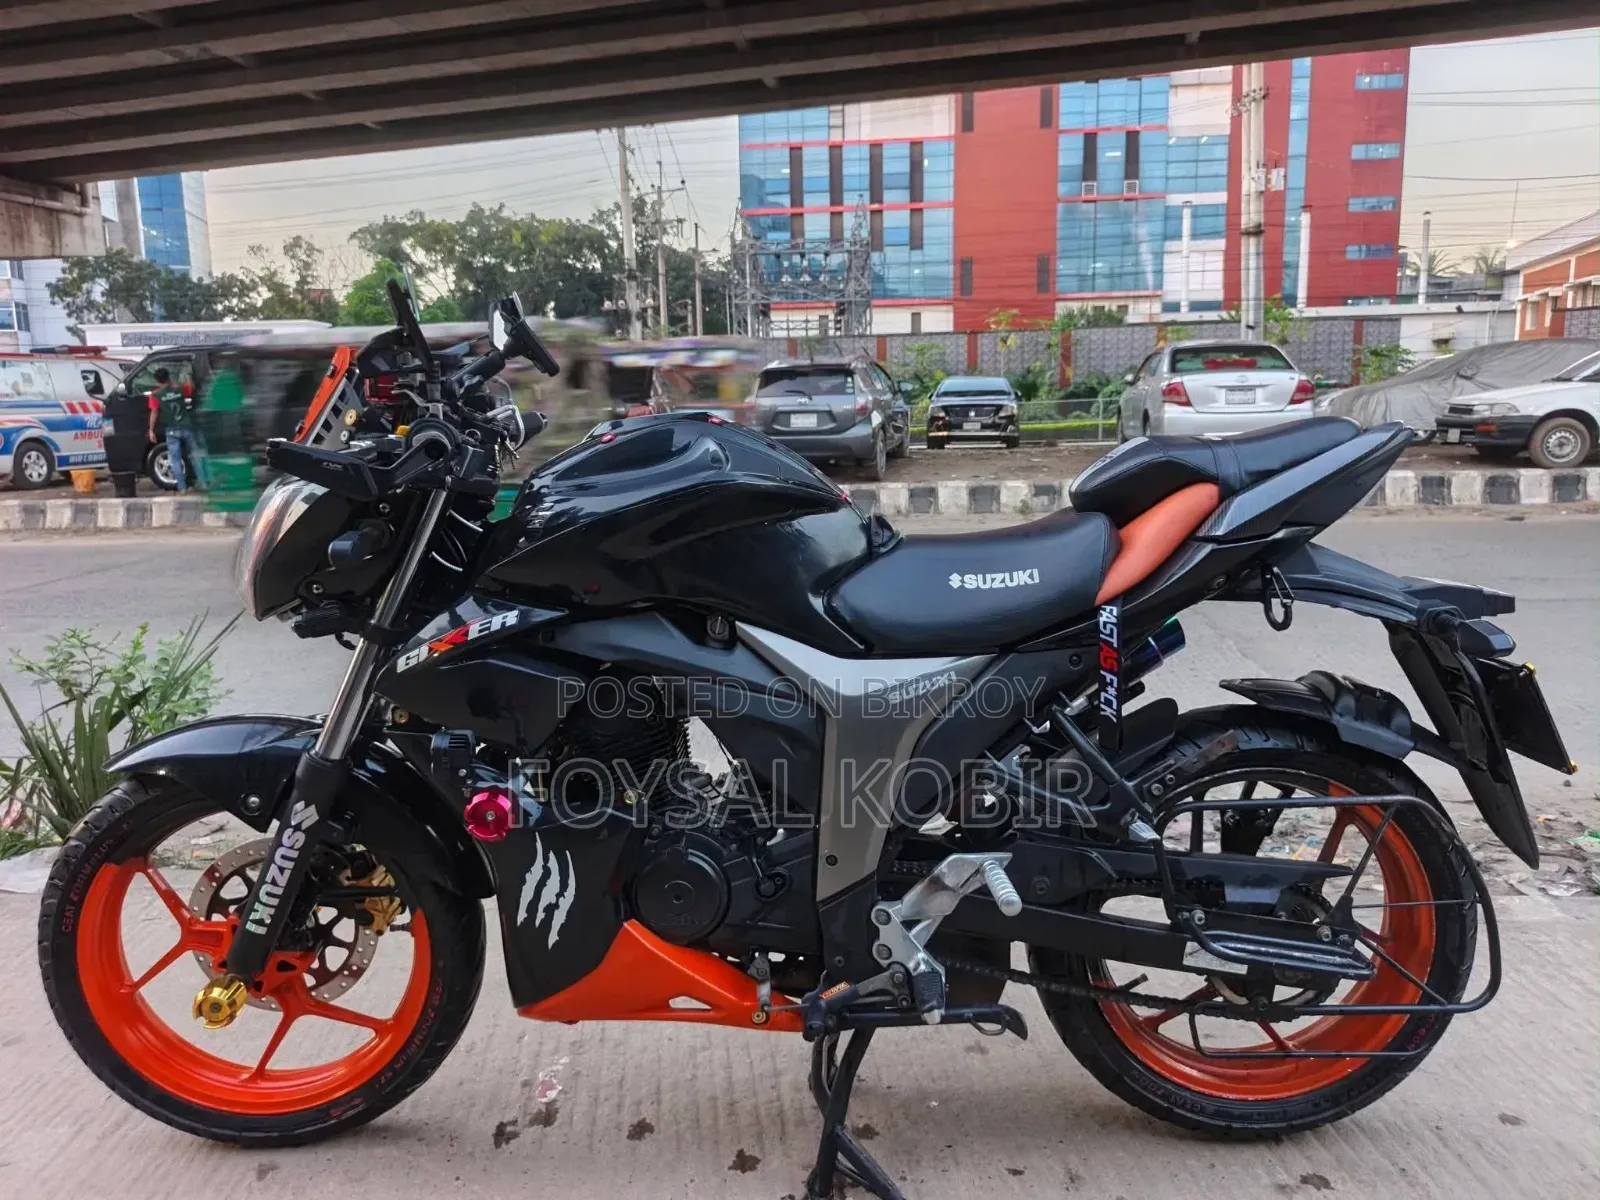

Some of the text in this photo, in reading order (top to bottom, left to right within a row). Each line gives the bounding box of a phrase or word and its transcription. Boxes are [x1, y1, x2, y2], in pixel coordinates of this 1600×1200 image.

[963, 568, 1040, 589] SUZUKI
[1099, 605, 1118, 648] FAST
[1099, 642, 1119, 672] AS
[888, 671, 958, 704] SUZUKI
[245, 827, 306, 935] SUZUKI
